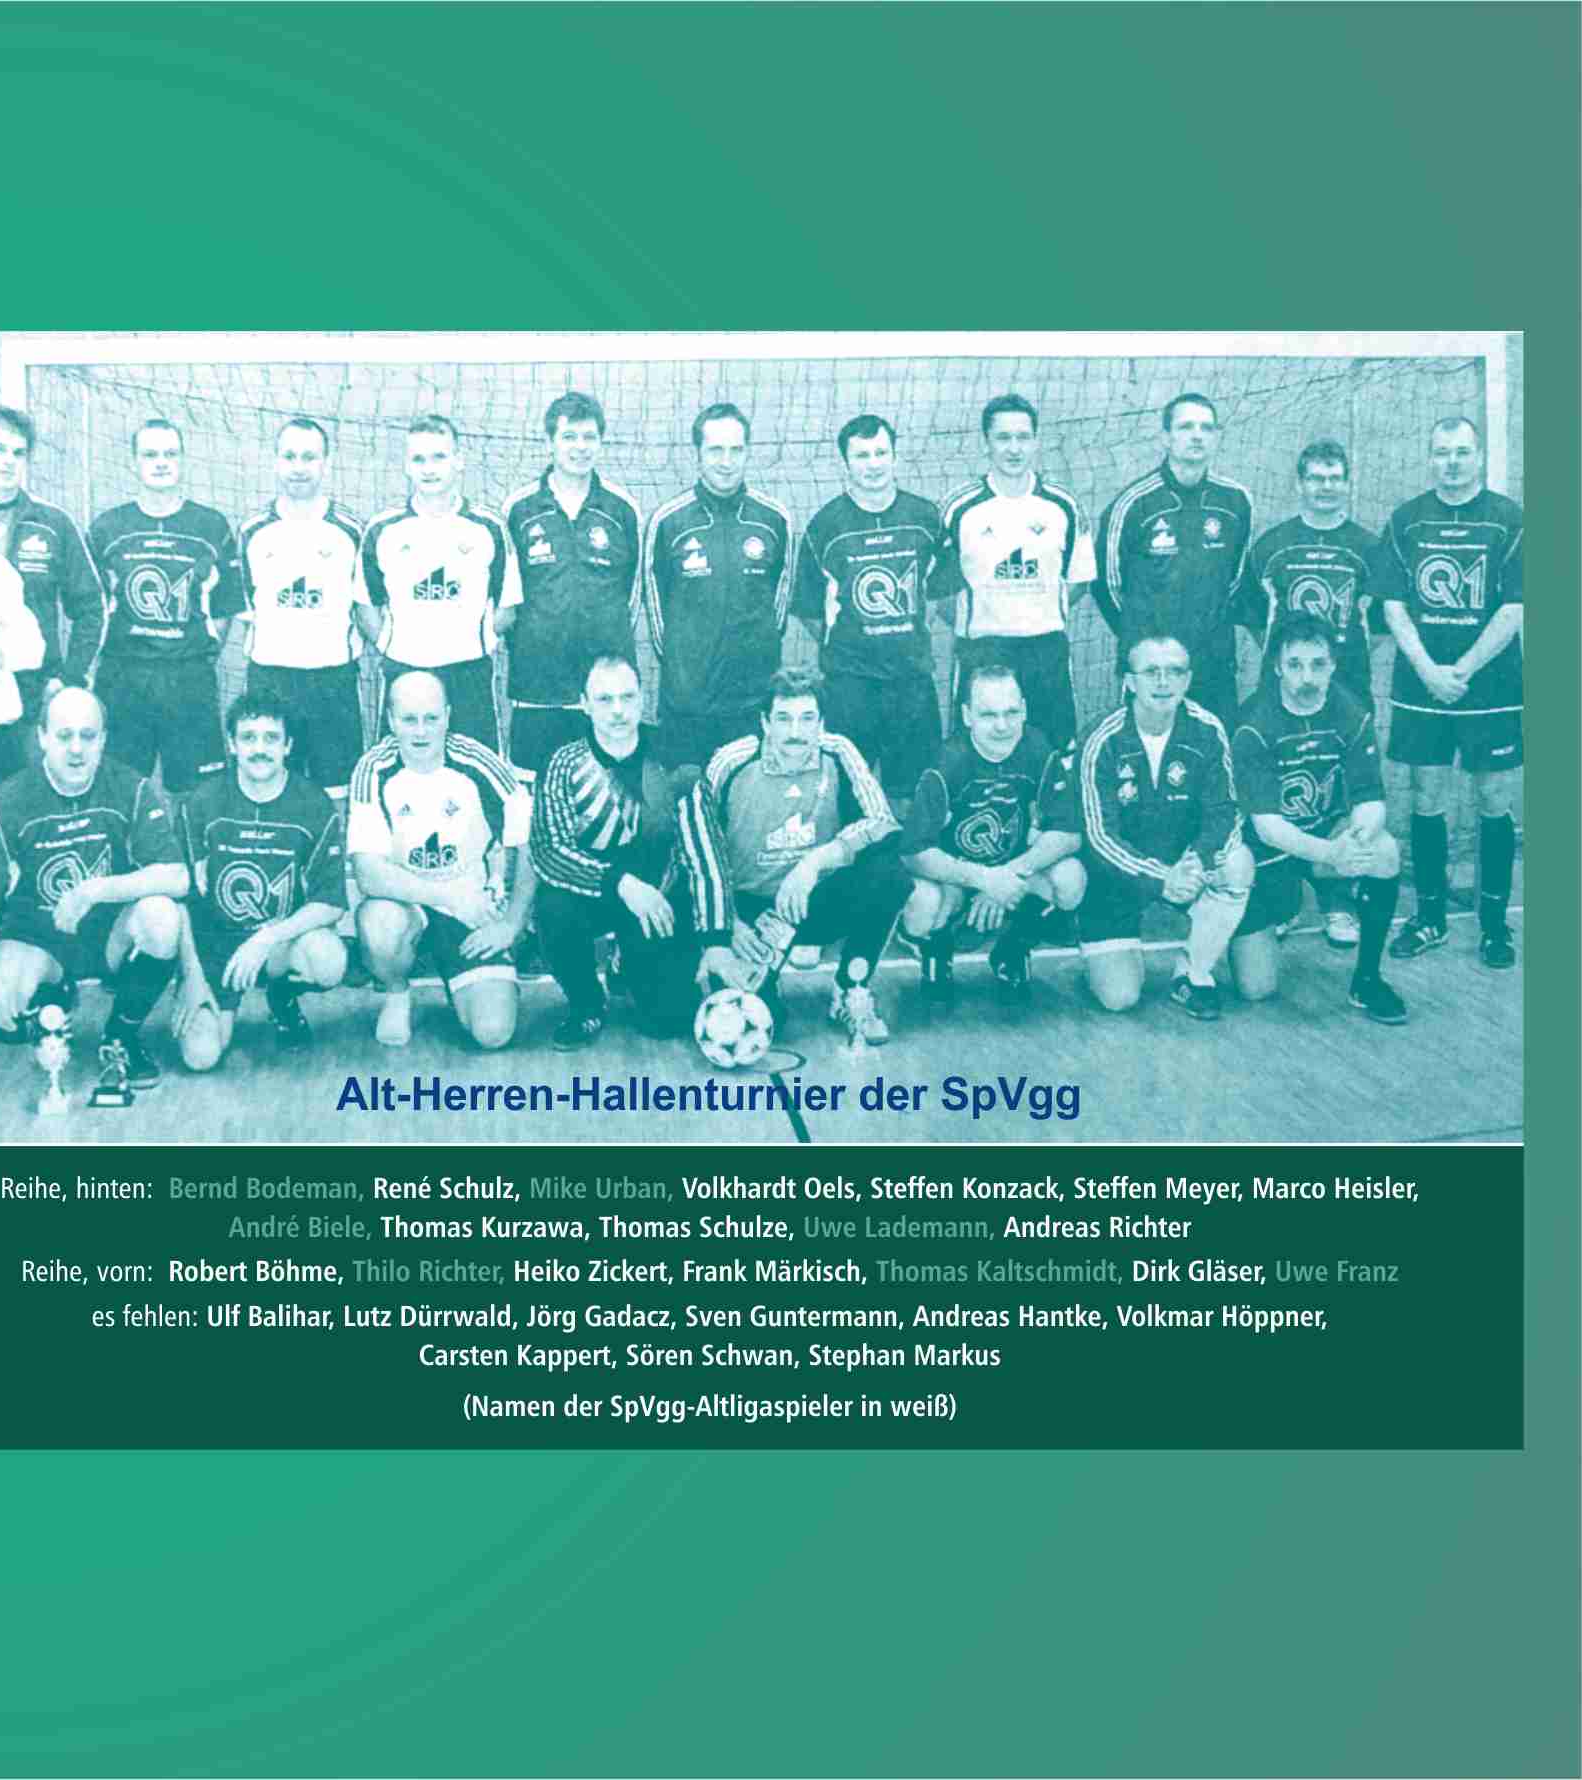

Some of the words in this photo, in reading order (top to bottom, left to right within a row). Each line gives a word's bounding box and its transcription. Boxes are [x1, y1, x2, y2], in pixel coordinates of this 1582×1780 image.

[126, 563, 194, 622] Q1
[852, 560, 918, 618] Q1
[1417, 554, 1486, 608] Q1
[216, 861, 296, 921] Q1
